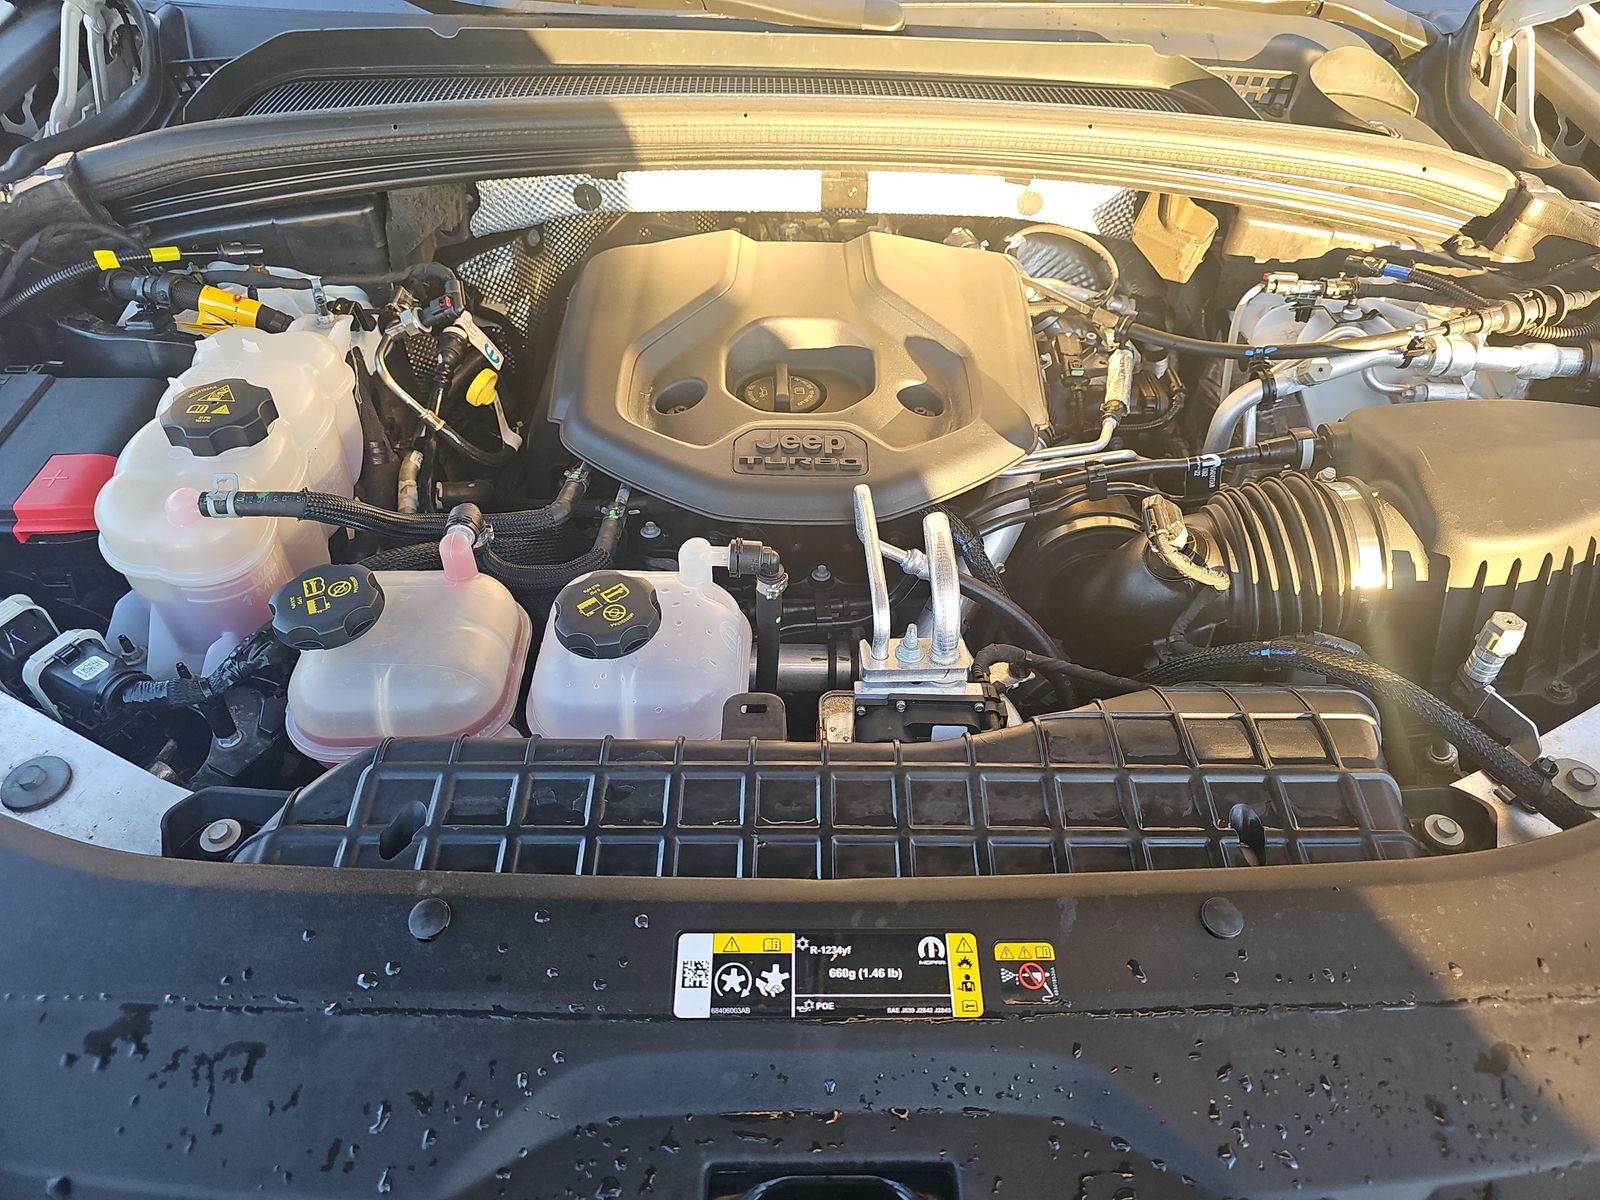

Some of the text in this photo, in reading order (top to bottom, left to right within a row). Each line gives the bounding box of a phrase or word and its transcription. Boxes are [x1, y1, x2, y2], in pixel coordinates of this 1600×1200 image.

[755, 431, 846, 457] Jeep
[738, 456, 863, 470] TURBO
[810, 945, 852, 957] R-1234yf
[828, 968, 903, 980] 660g (1.46 lb)
[815, 1002, 835, 1010] POE
